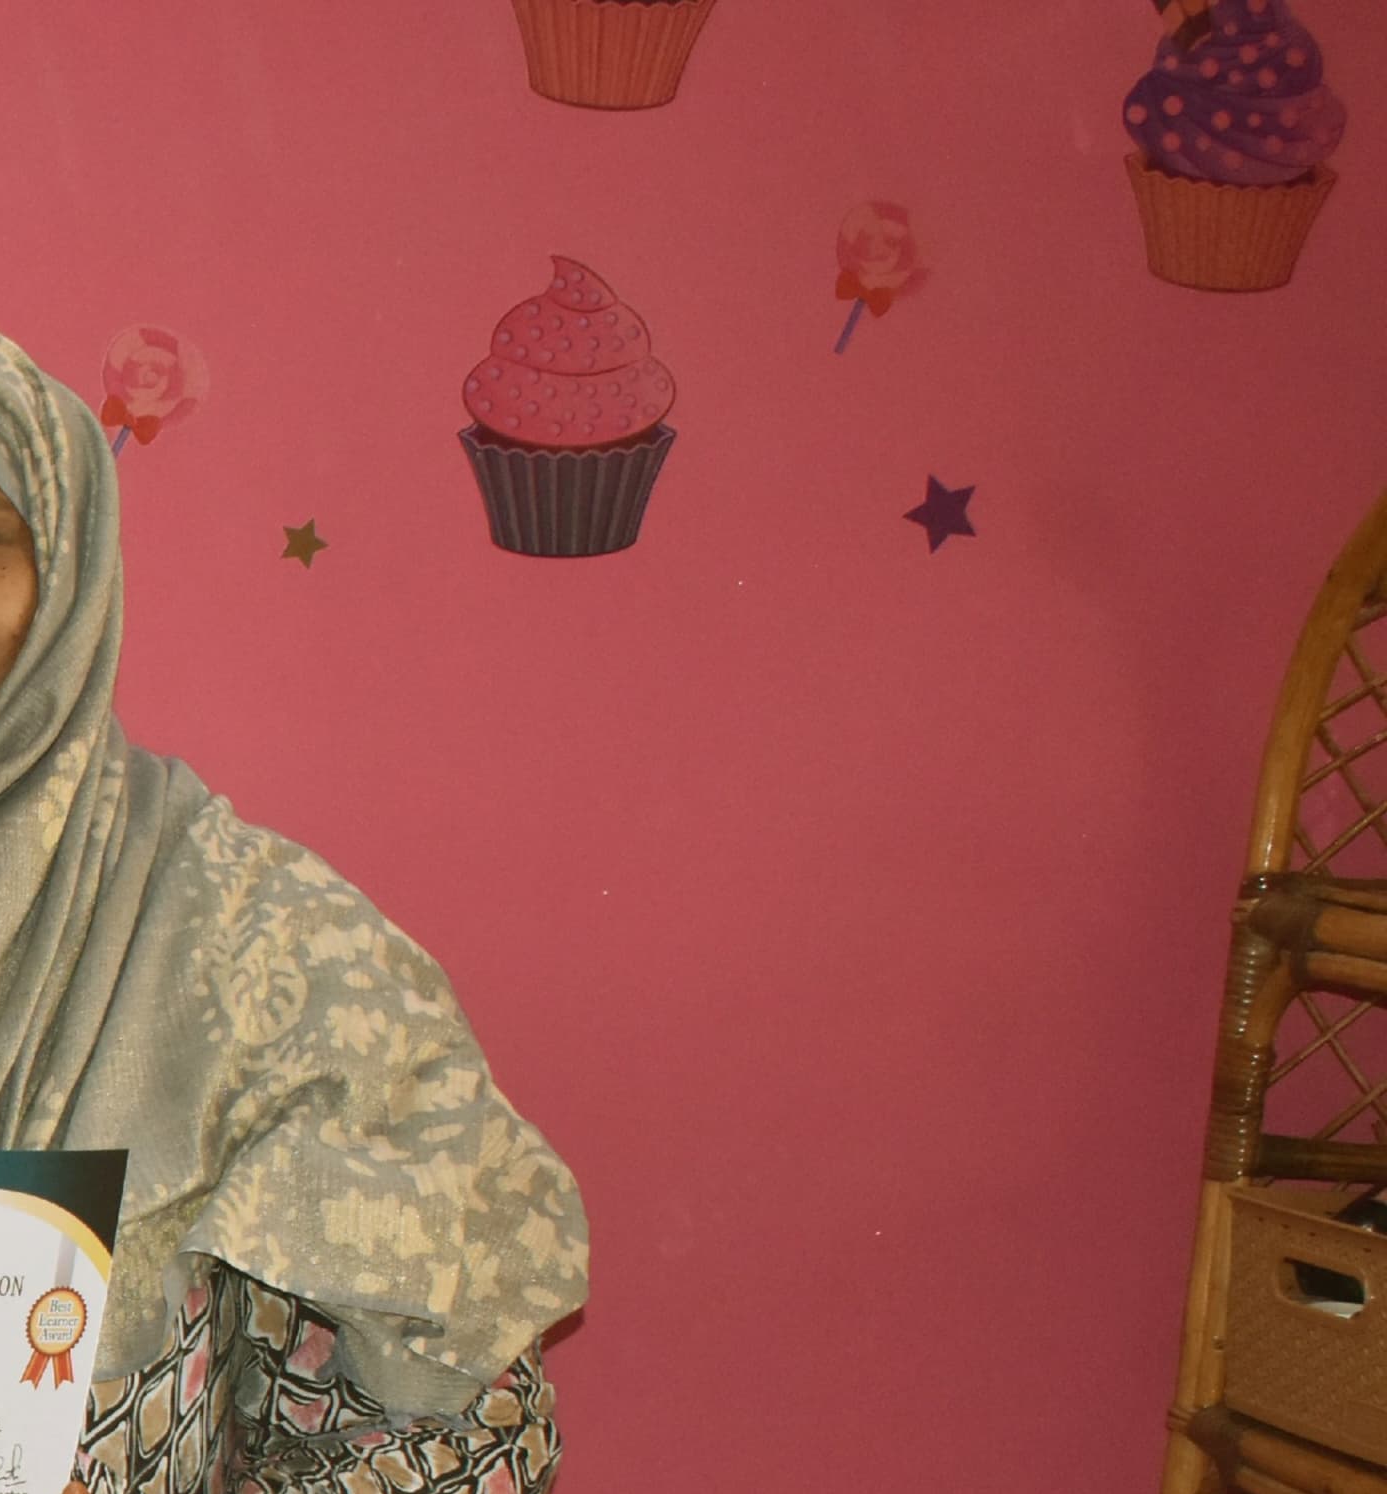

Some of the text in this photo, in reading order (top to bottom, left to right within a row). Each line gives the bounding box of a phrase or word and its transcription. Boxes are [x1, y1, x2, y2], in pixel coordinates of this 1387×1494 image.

[49, 1299, 72, 1313] Best
[39, 1314, 79, 1328] Learner
[40, 1328, 73, 1342] Award
